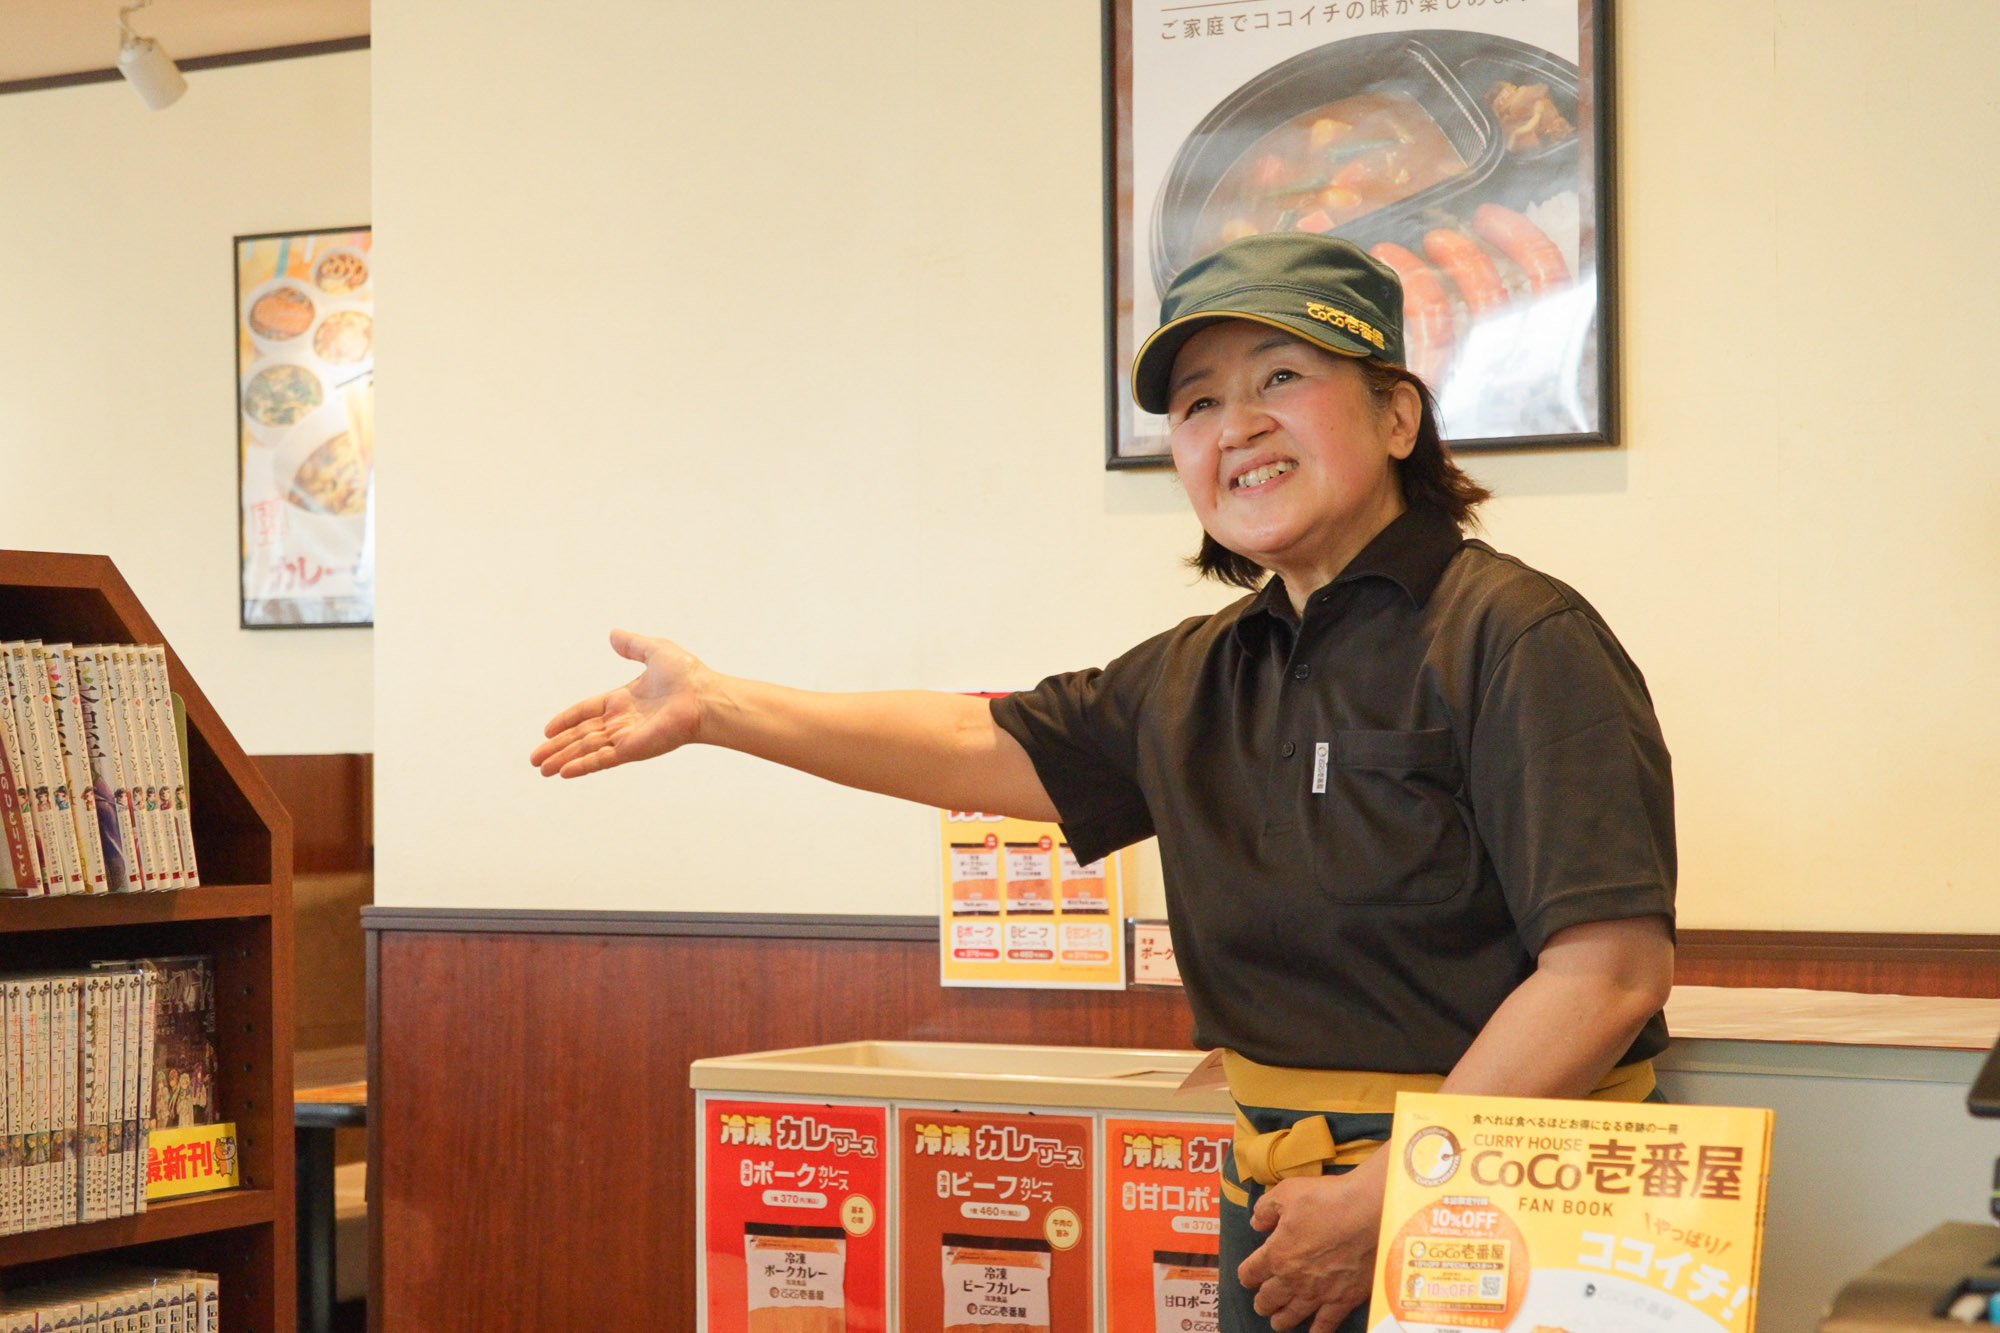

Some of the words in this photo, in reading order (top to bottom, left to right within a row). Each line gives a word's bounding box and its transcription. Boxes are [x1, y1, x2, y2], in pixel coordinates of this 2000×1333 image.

[1161, 0, 1528, 40] ご家庭でココイチの味が楽
[1018, 926, 1049, 938] ビーフ
[57, 1116, 63, 1128] 8
[70, 1114, 77, 1126] 9
[89, 1111, 97, 1123] 10
[1473, 1114, 1679, 1135] 食べれば食べるほどお得になる奇跡の一冊
[14, 1120, 21, 1133] 5
[30, 1119, 37, 1132] 6
[720, 1114, 773, 1146] 冷凍
[915, 1123, 971, 1157] 冷凍
[1473, 1134, 1524, 1149] CURRY
[1528, 1137, 1583, 1151] HOUSE
[1123, 1134, 1183, 1169] 冷凍
[753, 1161, 816, 1188] ポーク
[818, 1165, 850, 1178] カレー
[1471, 1139, 1744, 1201] CoCo壱番屋
[818, 1178, 850, 1191] ソース
[951, 1171, 1018, 1199] ビーフ
[1020, 1176, 1053, 1190] カレー
[1020, 1190, 1053, 1203] ソース
[1518, 1197, 1554, 1213] FAN
[1562, 1199, 1614, 1217] BOOK
[1432, 1208, 1498, 1230] 10%OFF
[1654, 1217, 1720, 1255] やっぱり
[785, 1252, 807, 1264] 冷凍
[764, 1264, 828, 1279] ポークカレー
[984, 1267, 1007, 1280] 冷凍
[1577, 1231, 1749, 1321] ココイチ!
[963, 1280, 1031, 1295] ビーフカレー
